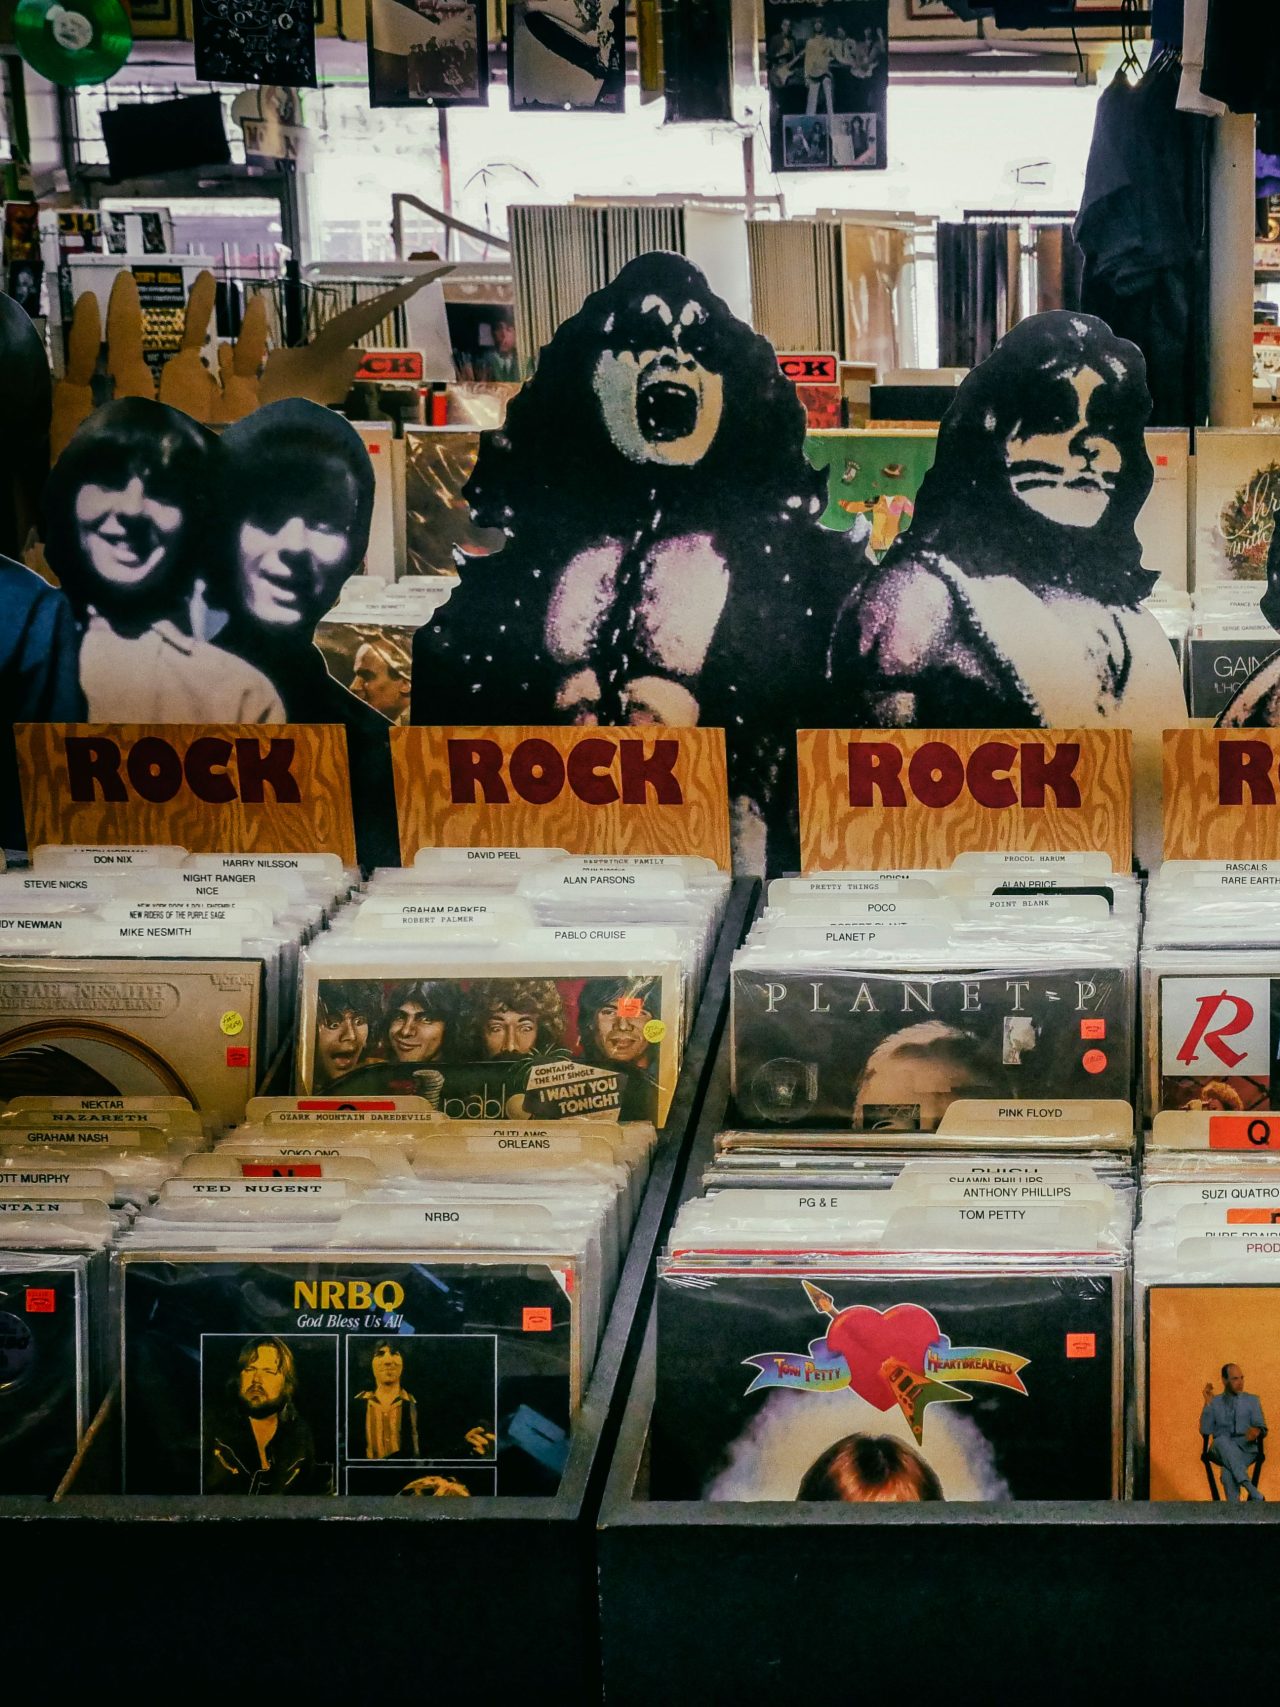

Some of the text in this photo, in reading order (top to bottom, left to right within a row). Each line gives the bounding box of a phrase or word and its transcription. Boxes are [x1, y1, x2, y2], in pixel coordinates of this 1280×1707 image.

[65, 737, 301, 802] ROCK
[448, 739, 683, 805] ROCK
[848, 741, 1081, 808] ROCK
[467, 851, 520, 859] DAVID PEEL
[94, 856, 133, 864] DON NIX
[222, 859, 298, 868] HARRY NILSSON
[183, 874, 256, 883] NIGHT RANGER
[563, 876, 635, 884] ALAN PARSONS
[1221, 876, 1247, 885] RARE
[24, 880, 88, 889] STEVIE NICKS
[196, 887, 219, 895] NICE
[867, 903, 896, 912] POCO
[130, 911, 226, 919] NEW RIDERS OF THE PURPLE SAGE
[402, 915, 474, 924] ROBERT PALMER
[17, 920, 62, 929] NEWMAN
[120, 928, 192, 937] MIKE NESMITH
[554, 930, 626, 939] PABLO CRUISE
[825, 933, 876, 941] PLANET P
[765, 981, 1097, 1012] PLANET P
[534, 1063, 575, 1076] CONTAINS
[534, 1068, 595, 1085] THE HIT SINGLE
[540, 1077, 618, 1102] I WANT YOU
[82, 1100, 124, 1109] NEKTAR
[559, 1092, 620, 1114] TONIGHT
[52, 1114, 148, 1122] NAZARETH
[279, 1113, 432, 1122] OZARK MOUNTAIN DAREDEVILS
[999, 1109, 1063, 1118] PINK FLOYD
[1247, 1119, 1270, 1146] Q
[27, 1133, 109, 1143] GRAHAM NASH
[498, 1140, 550, 1149] ORLEANS
[20, 1174, 70, 1184] MURPHY
[193, 1185, 322, 1193] TED NUGENT
[963, 1187, 1071, 1197] ANTHONY PHILLIPS
[1202, 1188, 1280, 1200] SUZI QUATRO
[799, 1198, 837, 1208] PG & E
[424, 1212, 460, 1222] NRBQ
[959, 1210, 1026, 1220] TOM PETTY
[293, 1281, 405, 1312] NRBQ
[297, 1315, 404, 1328] God Bless Us All
[928, 1352, 1014, 1376] HEARTBREAKERS
[774, 1358, 841, 1381] TOM PETTY
